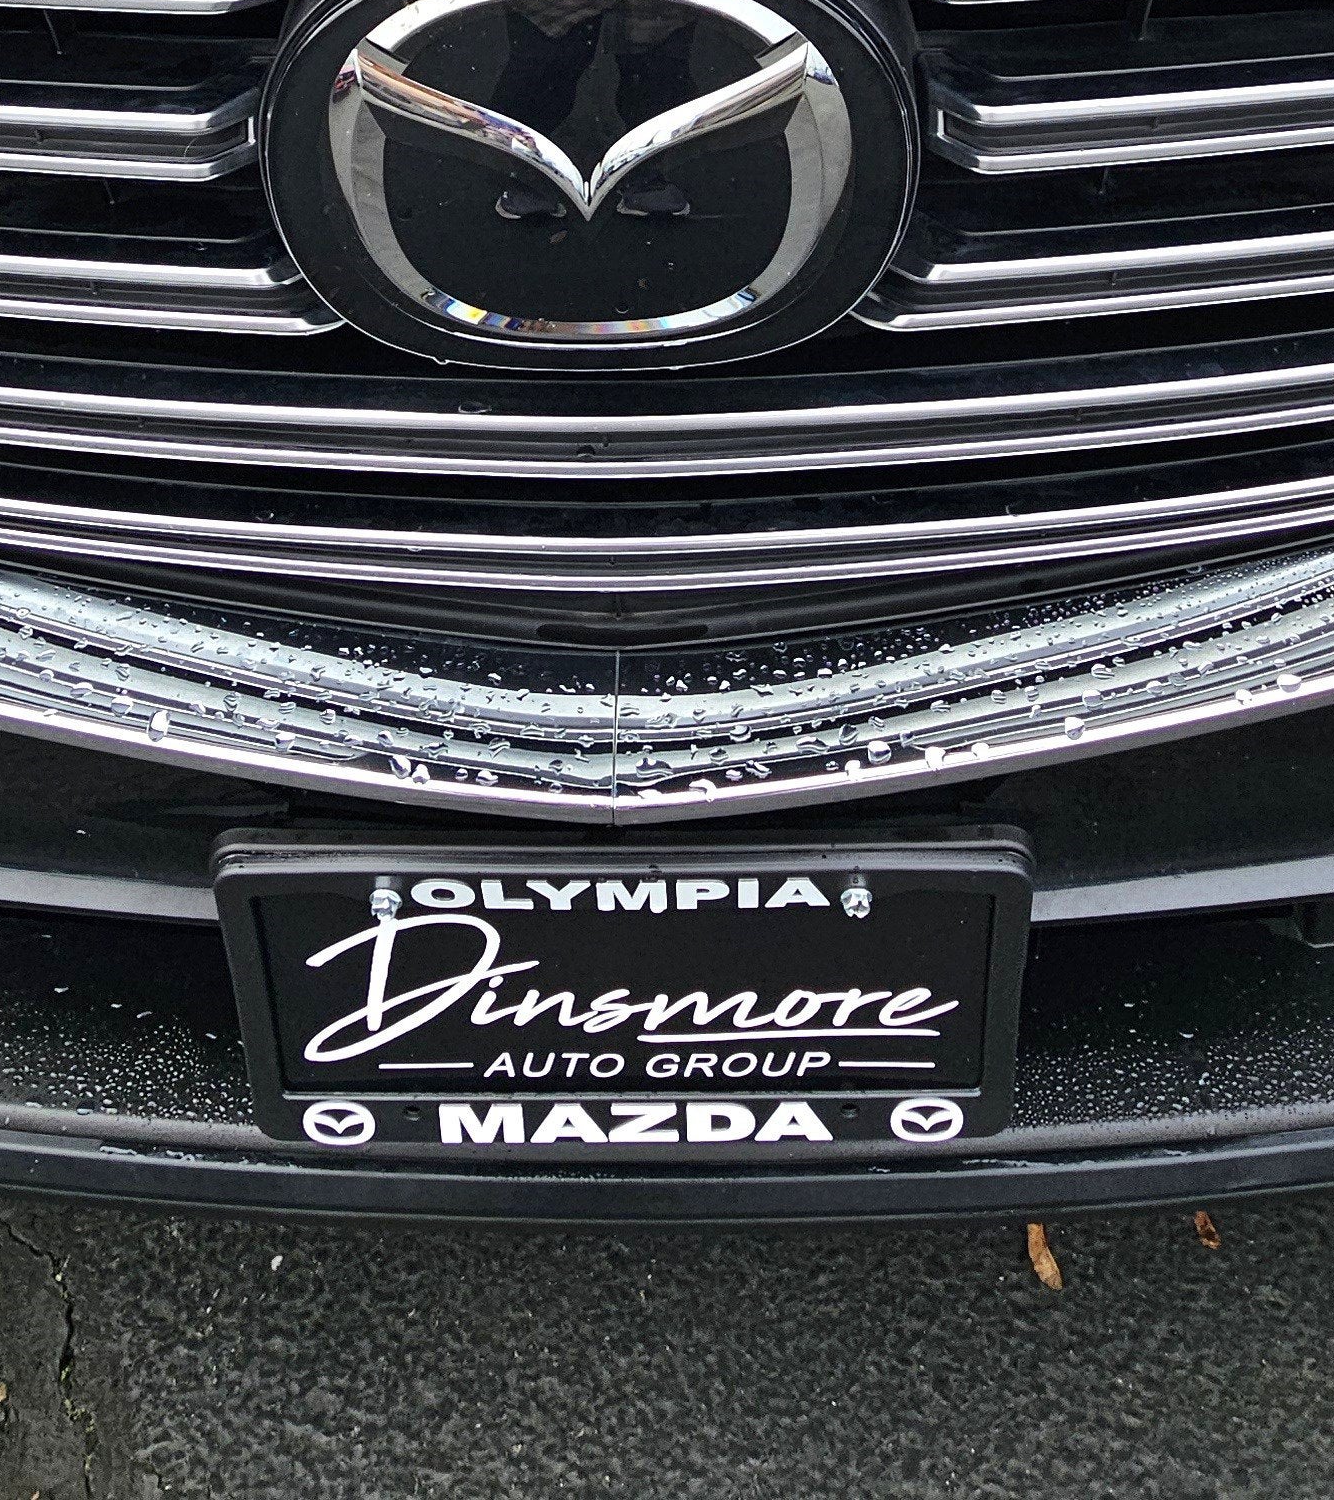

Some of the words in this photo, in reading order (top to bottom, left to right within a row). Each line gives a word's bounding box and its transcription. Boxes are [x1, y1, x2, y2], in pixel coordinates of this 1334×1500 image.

[410, 878, 830, 913] OLYMPIA
[303, 913, 959, 1062] Dinsmore
[483, 1052, 625, 1077] AUTO
[645, 1051, 831, 1077] GROUP
[438, 1102, 834, 1144] MAZDA
